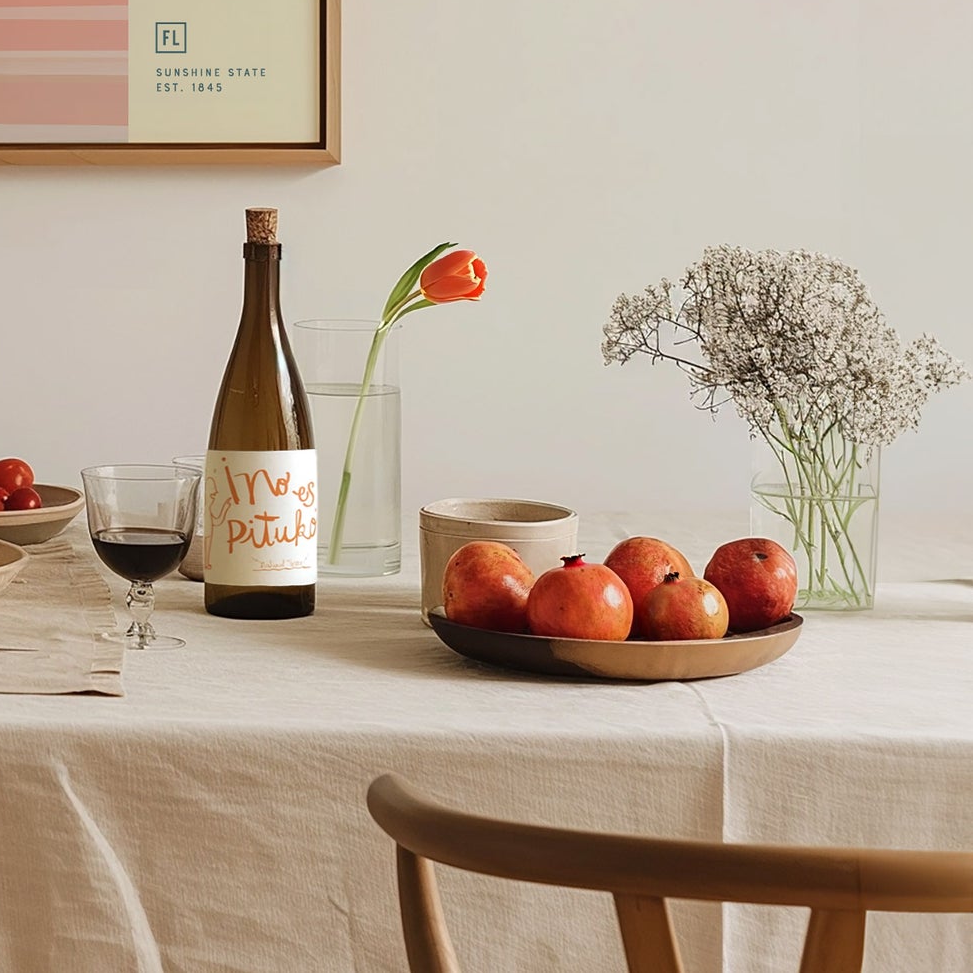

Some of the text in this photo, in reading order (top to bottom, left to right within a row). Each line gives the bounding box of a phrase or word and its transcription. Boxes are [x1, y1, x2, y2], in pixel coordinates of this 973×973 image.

[162, 29, 180, 46] FL
[156, 68, 266, 77] SUNSHINE STATE
[156, 83, 223, 92] EST. 1845
[292, 481, 315, 508] es
